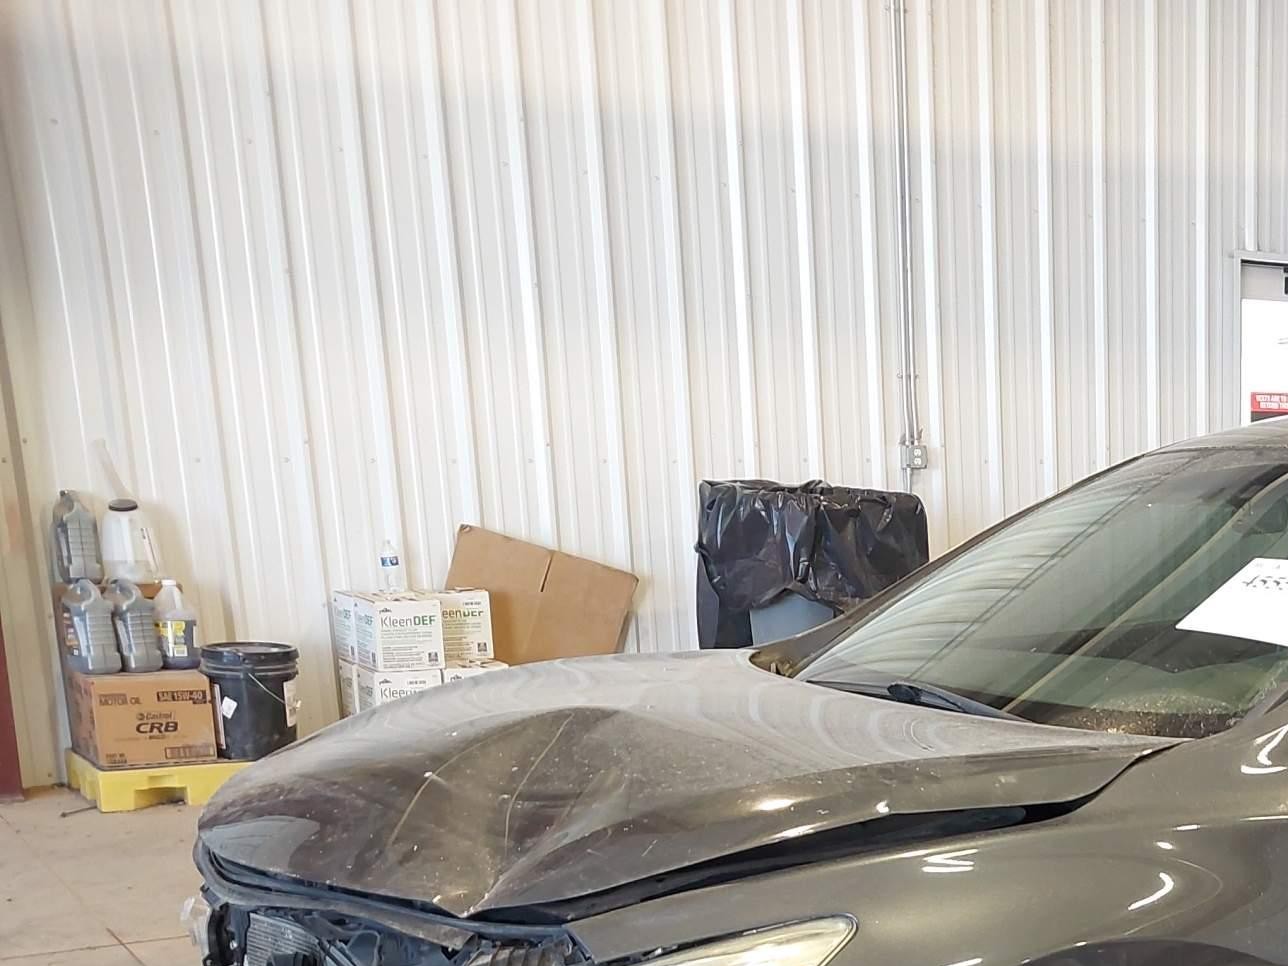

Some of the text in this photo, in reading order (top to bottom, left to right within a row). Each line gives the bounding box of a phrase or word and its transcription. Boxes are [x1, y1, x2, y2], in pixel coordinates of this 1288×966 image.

[380, 615, 436, 628] KleenDEF
[130, 696, 142, 705] OIL
[136, 721, 179, 734] CRB
